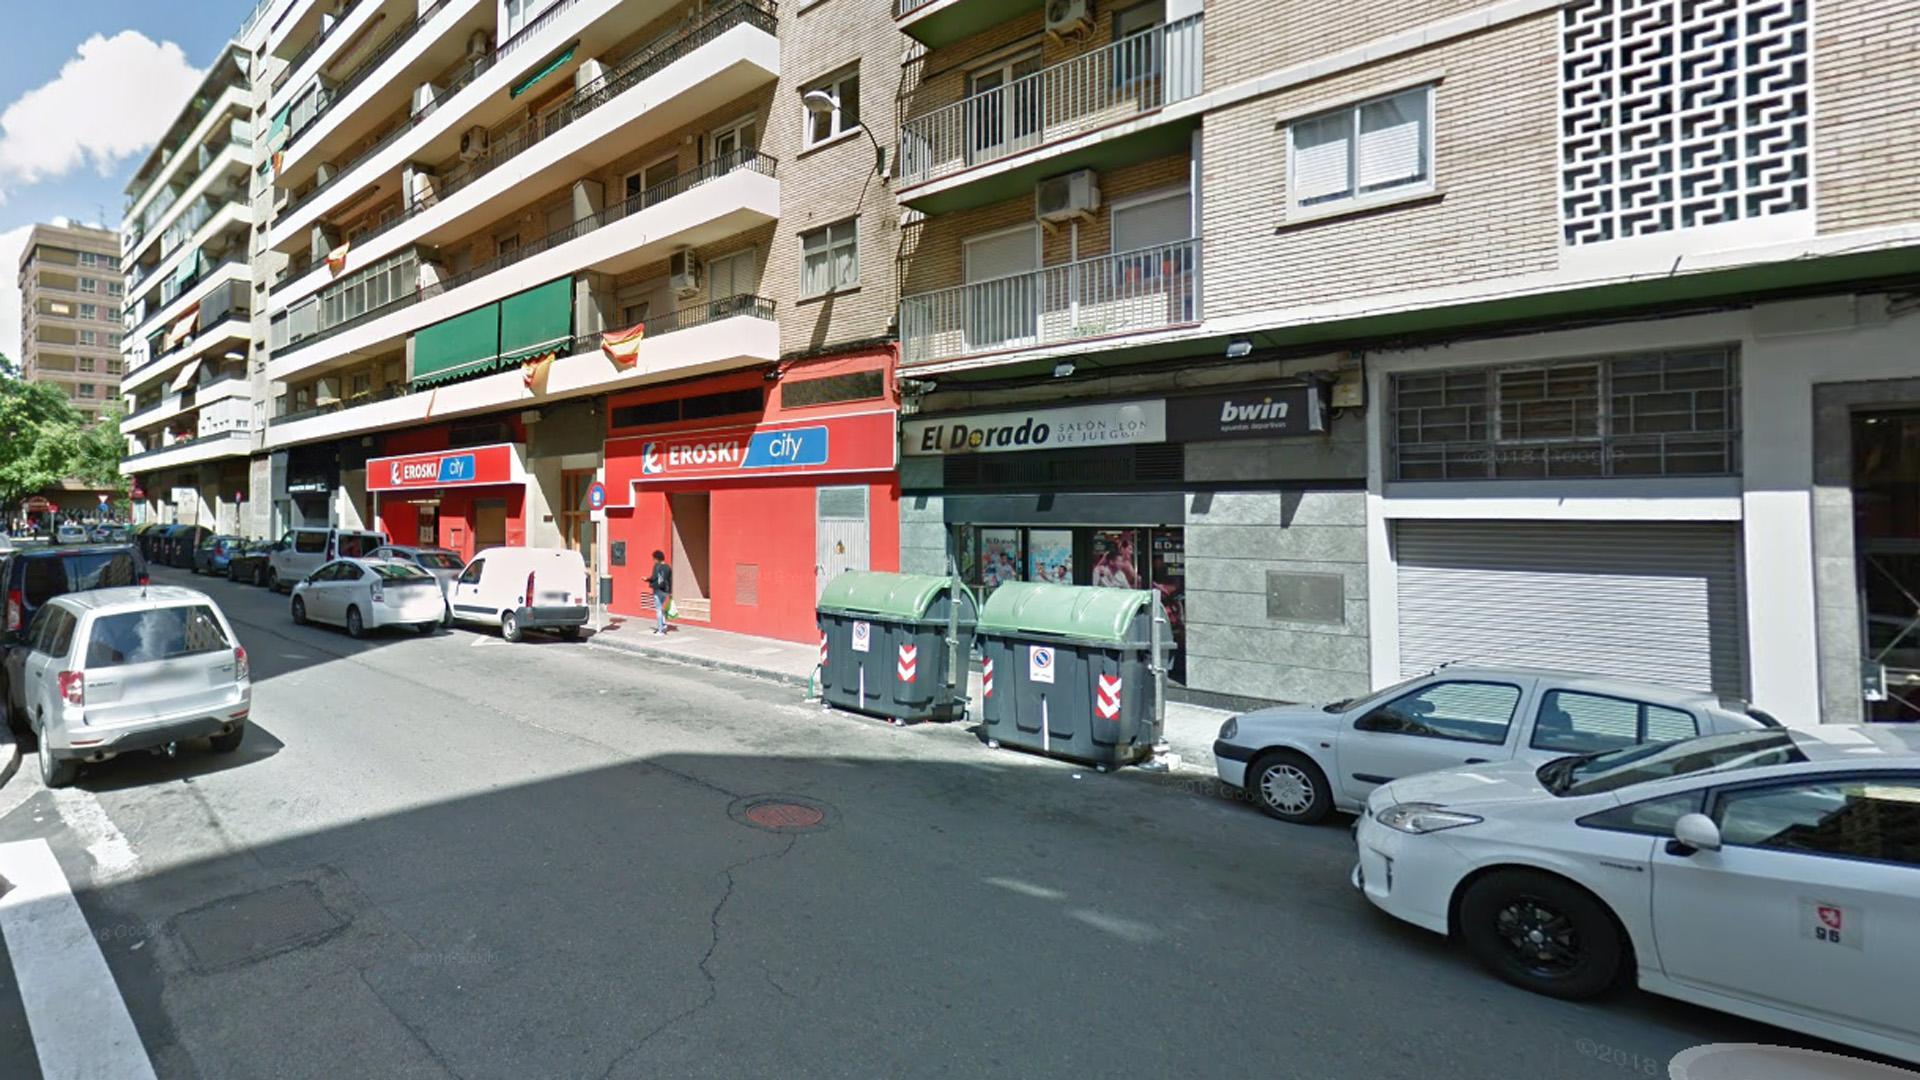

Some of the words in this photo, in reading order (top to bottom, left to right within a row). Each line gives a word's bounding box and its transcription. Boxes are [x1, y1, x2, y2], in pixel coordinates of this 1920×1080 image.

[1220, 397, 1288, 422] bwin
[950, 417, 1050, 448] Dorado
[1057, 432, 1073, 443] DE
[669, 440, 739, 466] EROSKI
[769, 432, 802, 460] city
[404, 463, 437, 479] EROSKI
[449, 458, 465, 477] city
